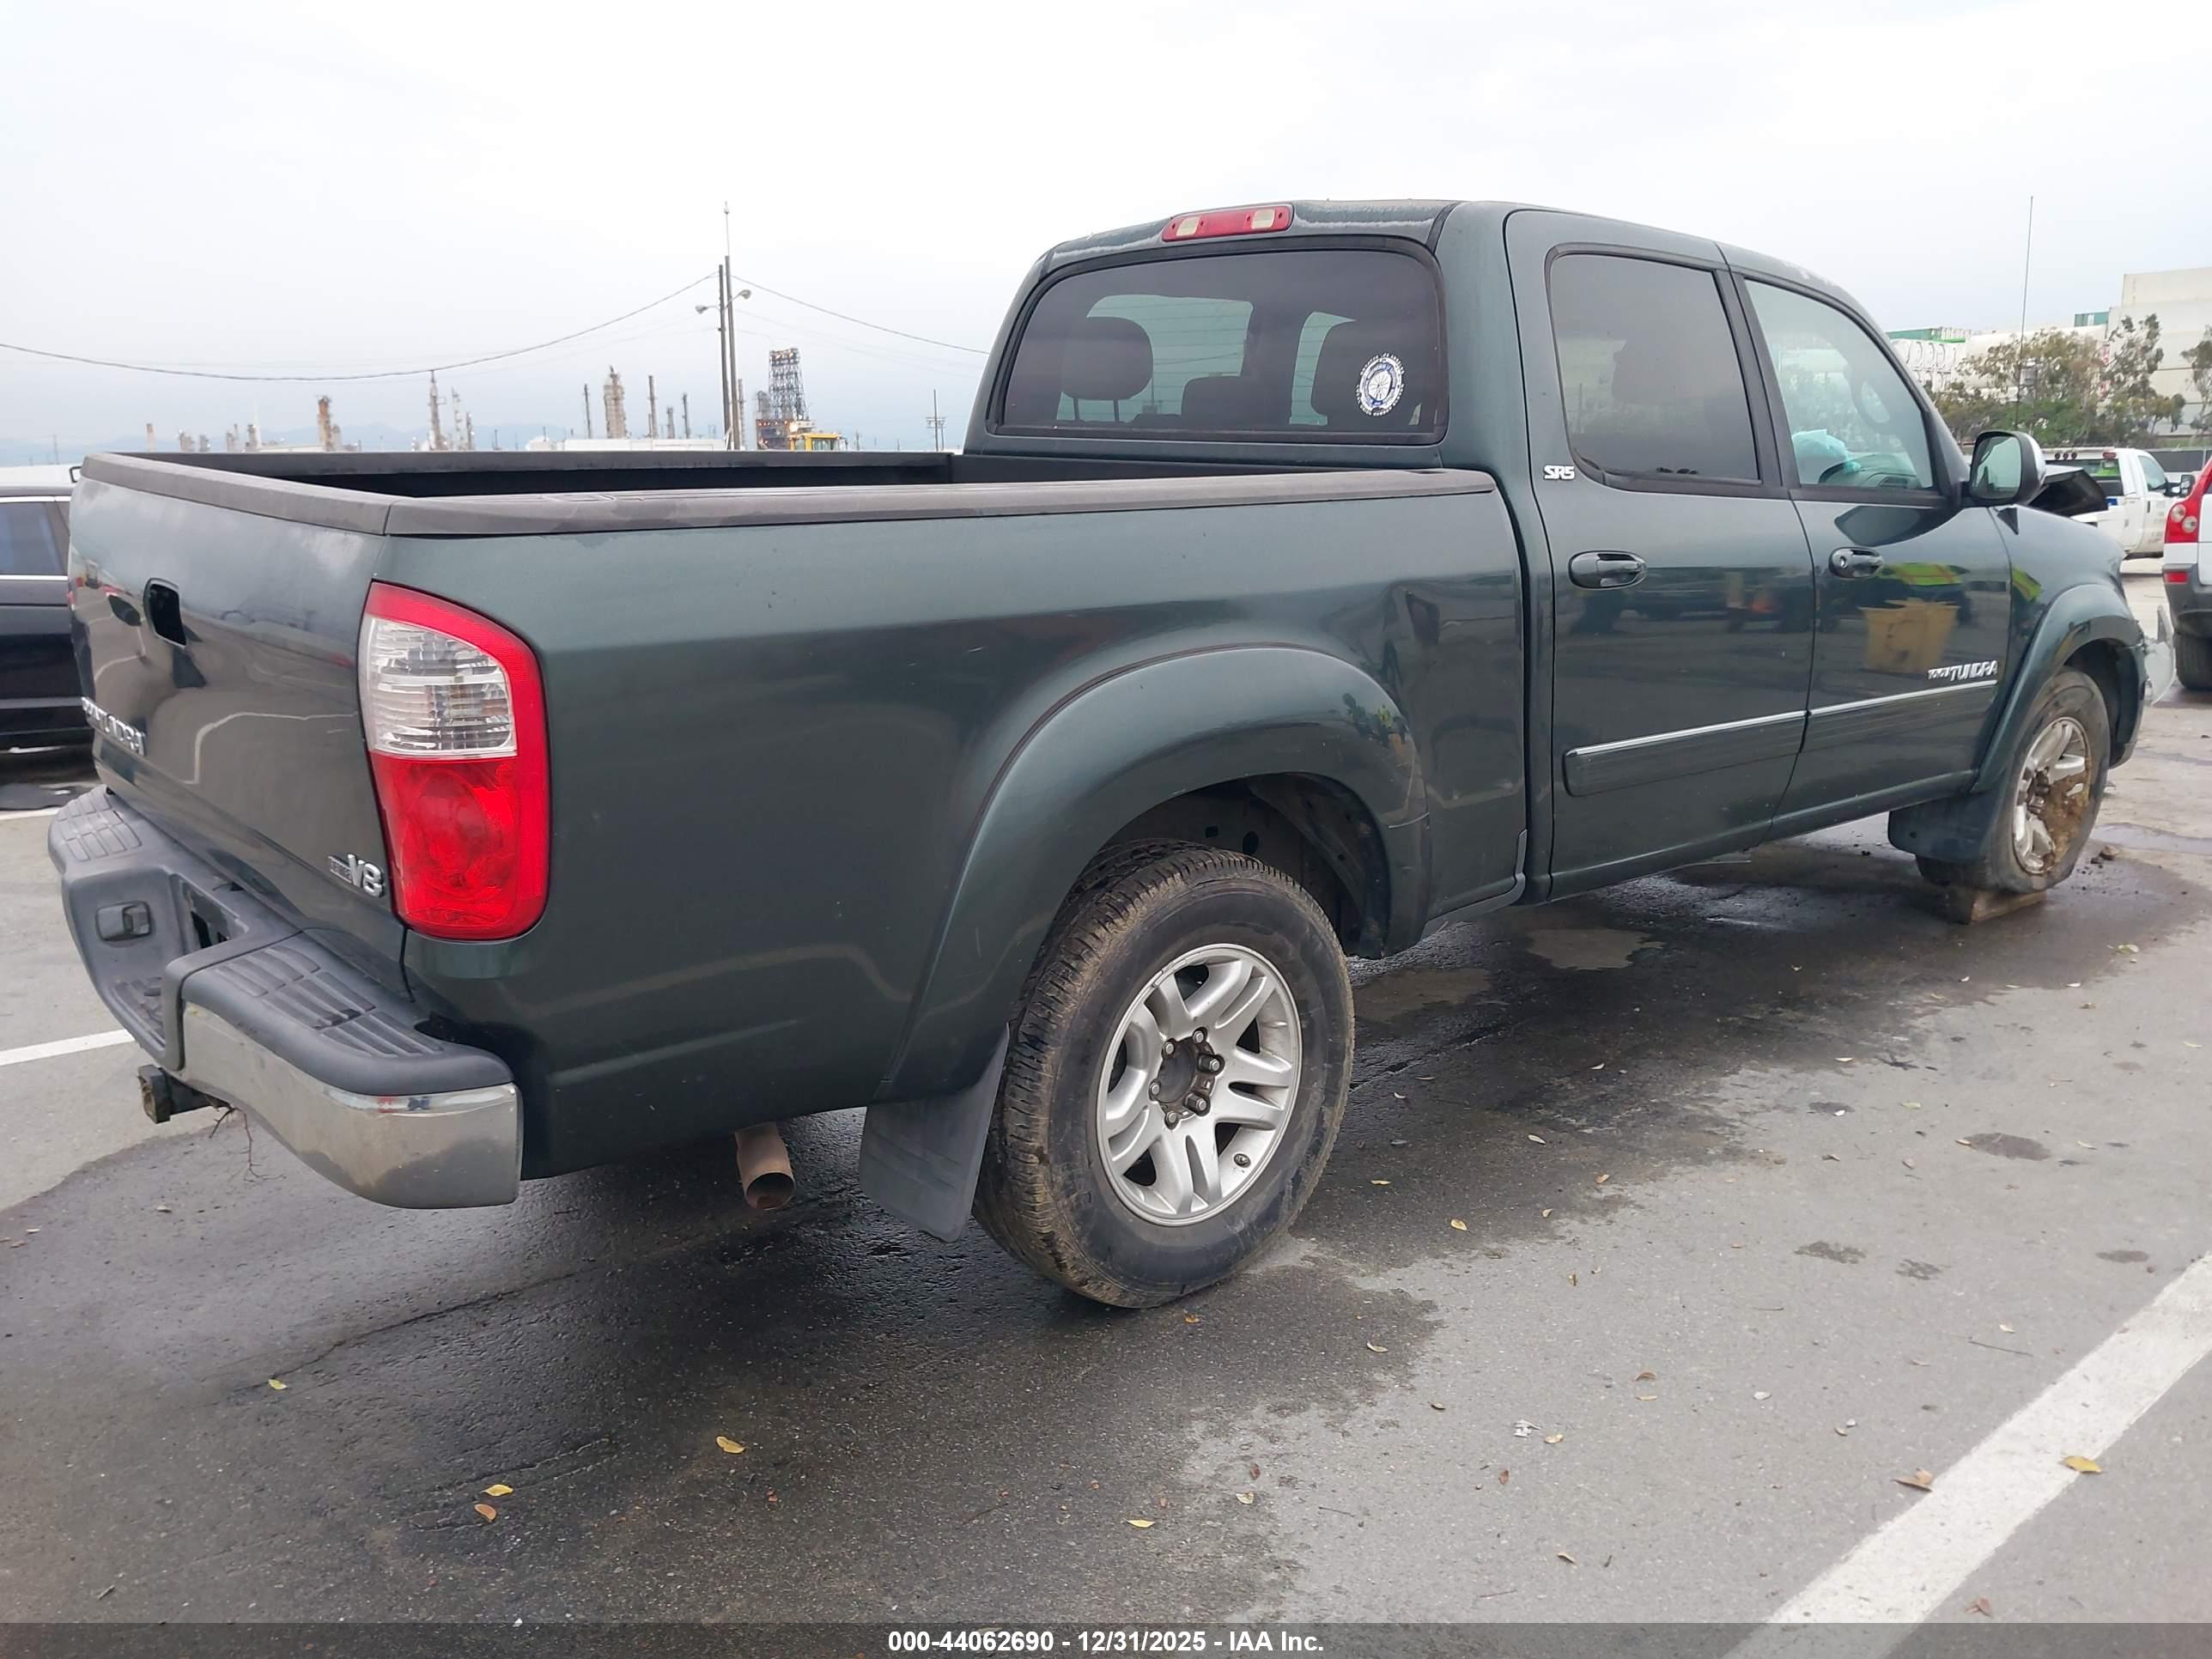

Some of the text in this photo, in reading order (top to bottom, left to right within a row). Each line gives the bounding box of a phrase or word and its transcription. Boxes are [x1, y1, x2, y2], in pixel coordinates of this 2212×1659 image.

[1544, 465, 1575, 480] SR5
[1950, 659, 1998, 681] TUNDRA
[347, 854, 383, 897] V8
